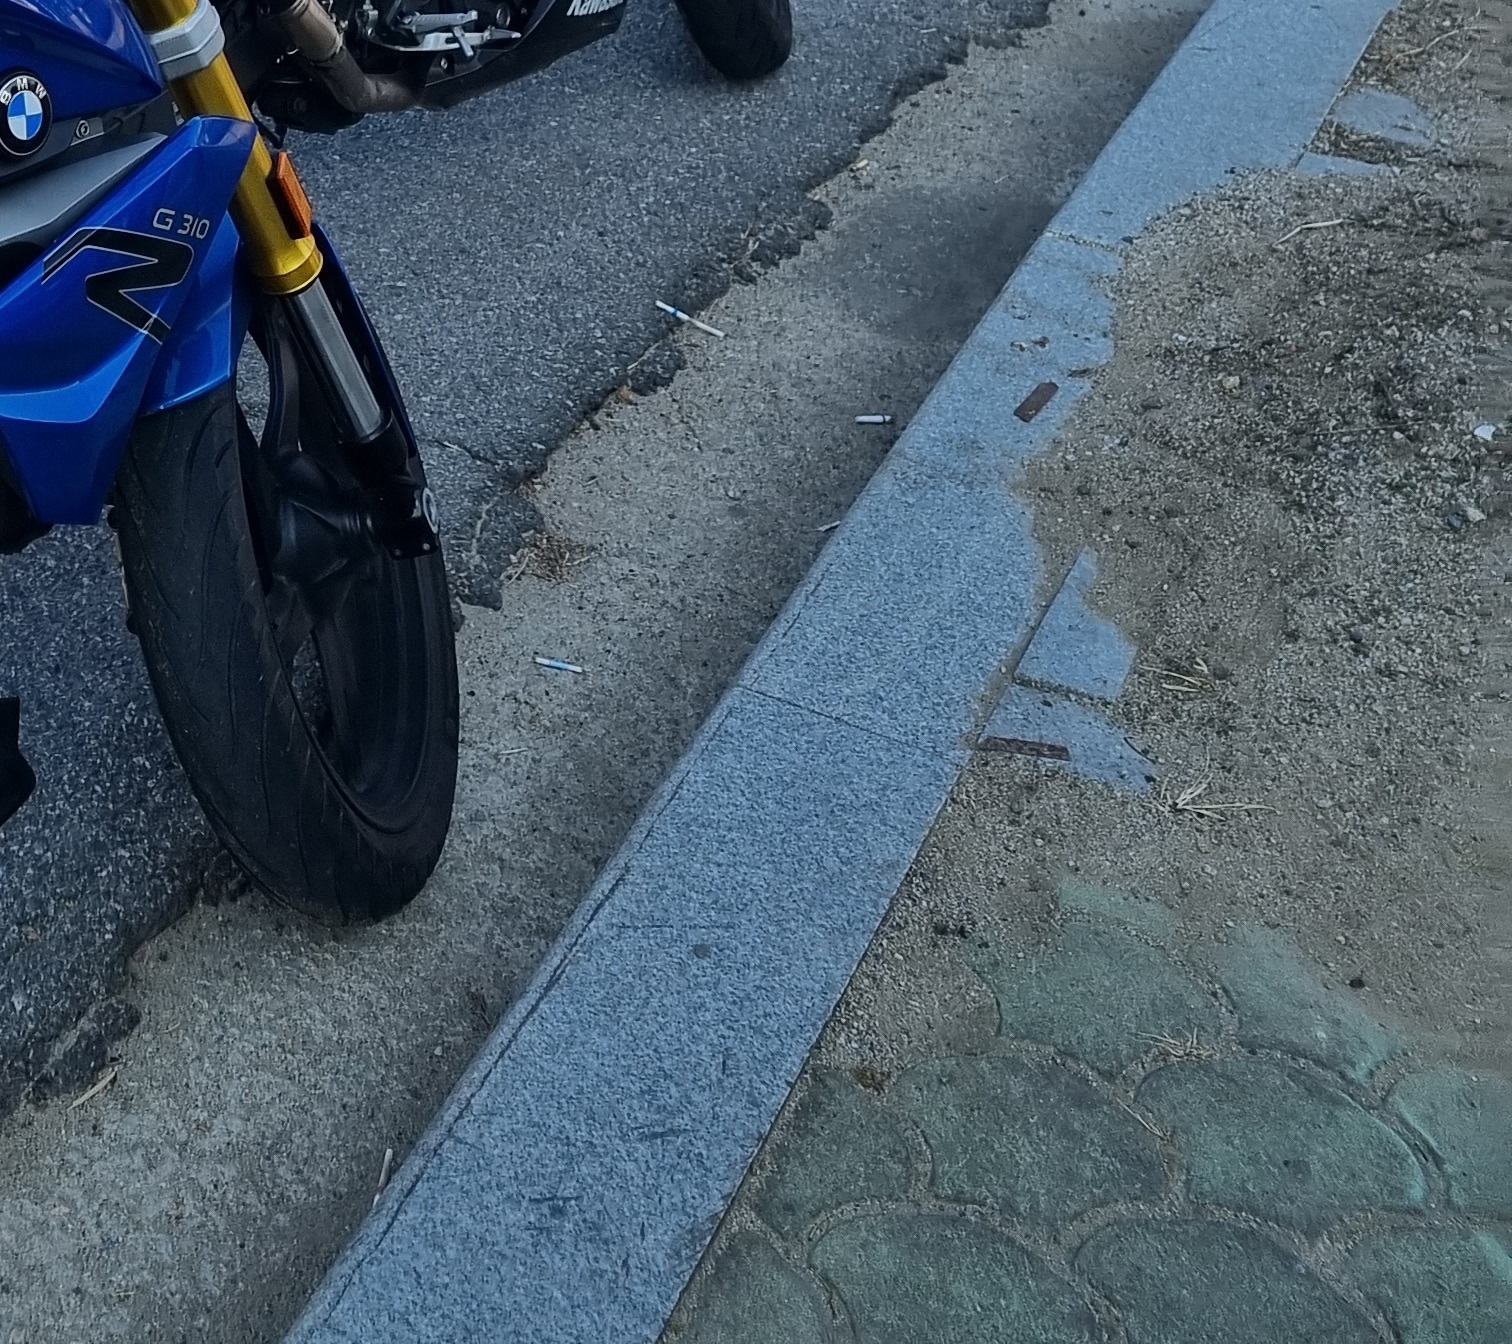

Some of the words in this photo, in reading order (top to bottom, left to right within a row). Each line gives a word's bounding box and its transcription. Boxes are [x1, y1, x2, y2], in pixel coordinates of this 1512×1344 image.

[0, 77, 48, 106] BMW
[153, 208, 176, 231] G
[176, 214, 210, 240] 310
